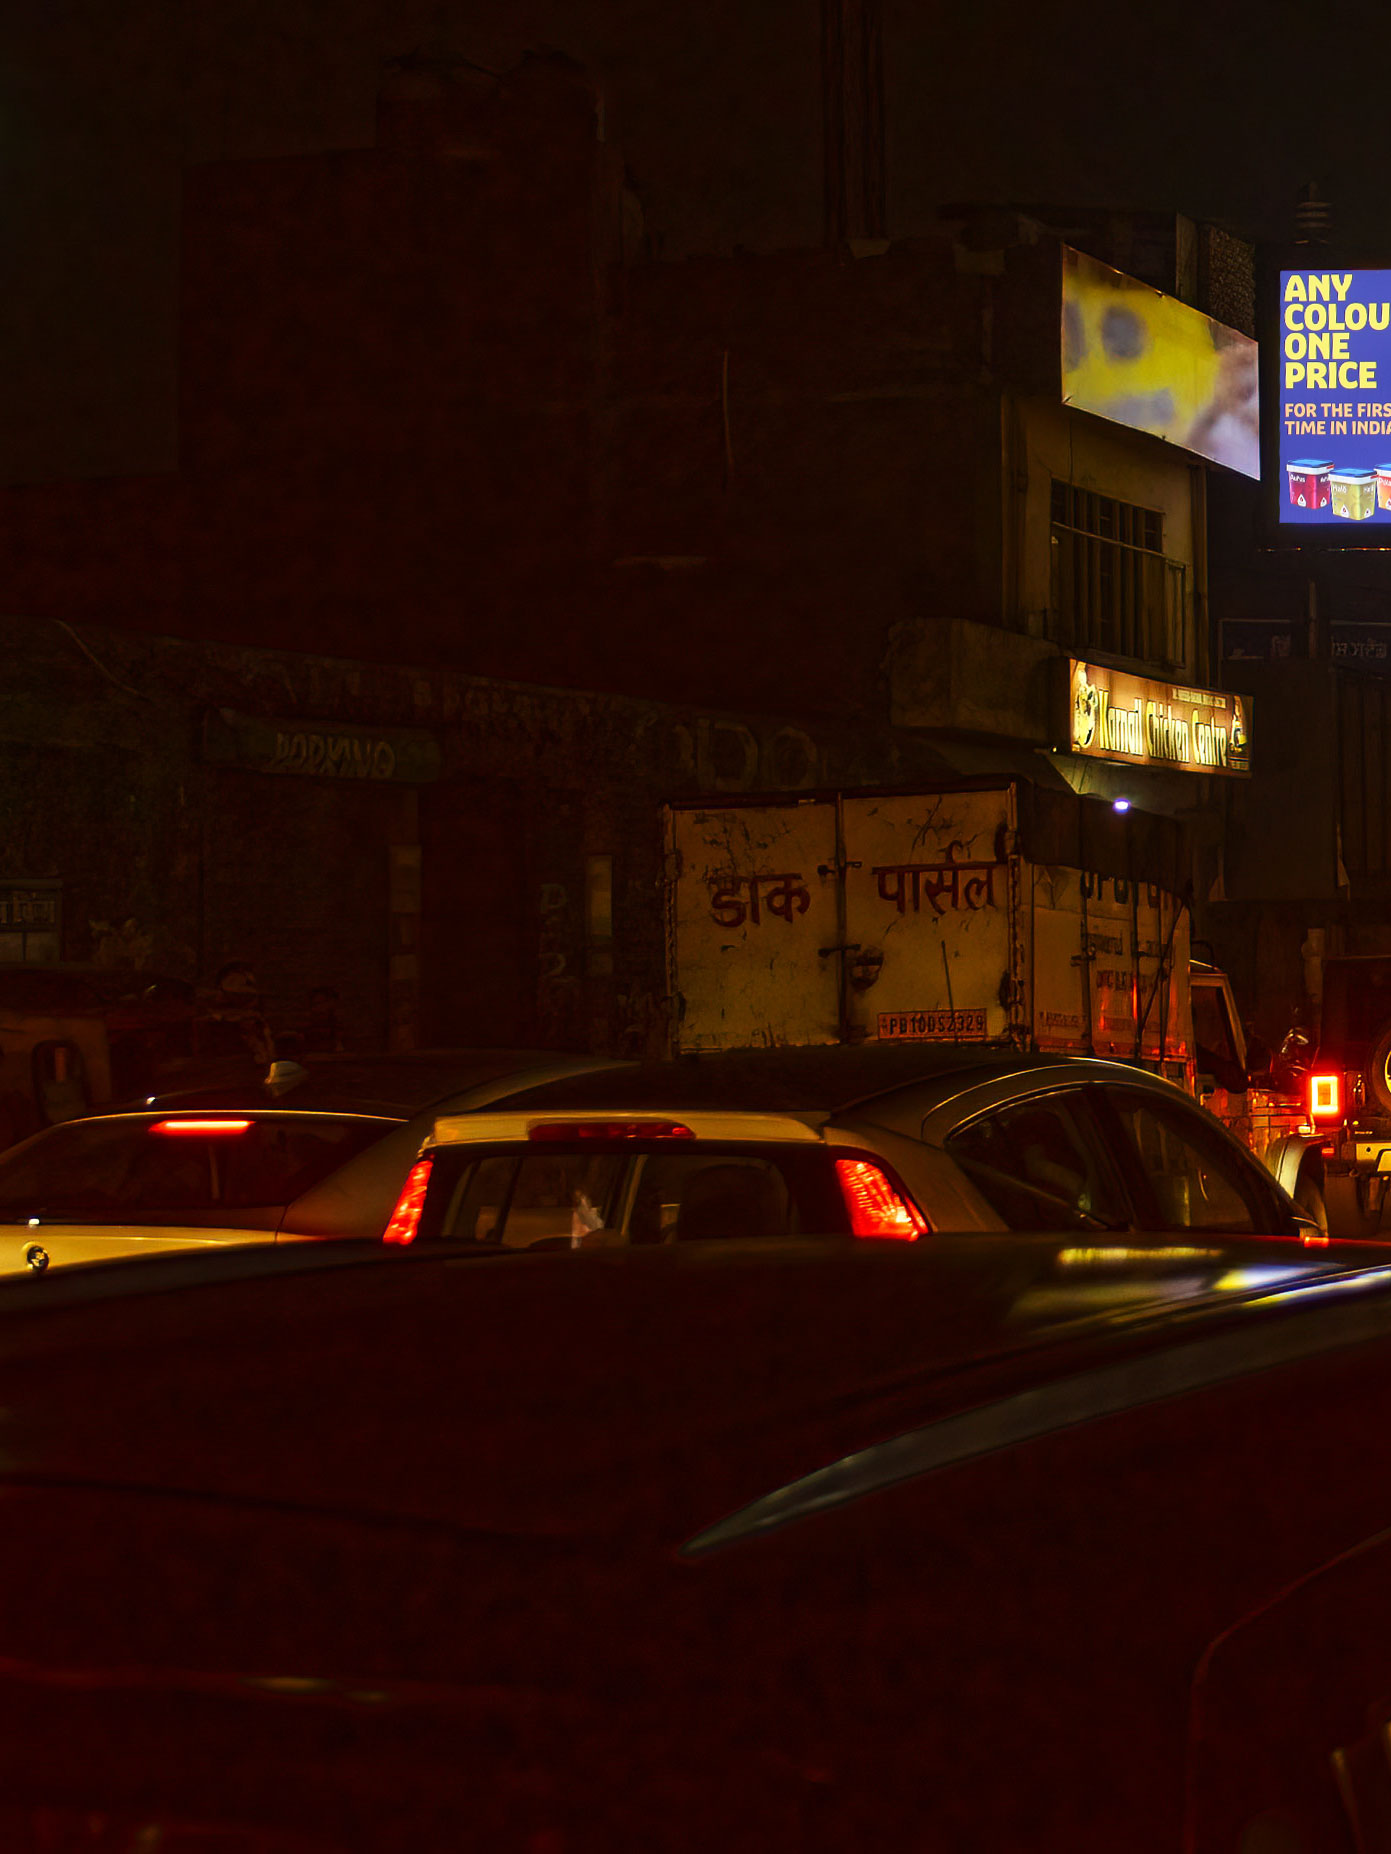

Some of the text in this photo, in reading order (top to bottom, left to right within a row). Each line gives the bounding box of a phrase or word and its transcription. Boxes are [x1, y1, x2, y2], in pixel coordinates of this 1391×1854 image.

[1284, 274, 1352, 302] ANY
[1284, 332, 1350, 360] ONE
[1285, 361, 1377, 389] PRICE
[1285, 403, 1317, 418] FOR
[1320, 403, 1353, 418] THE
[1284, 421, 1326, 435] TIME
[1330, 421, 1347, 435] IN
[1146, 700, 1190, 762] Chicken
[1192, 708, 1227, 767] Centre
[708, 873, 811, 927] डाक
[872, 840, 1004, 915] पार्सल
